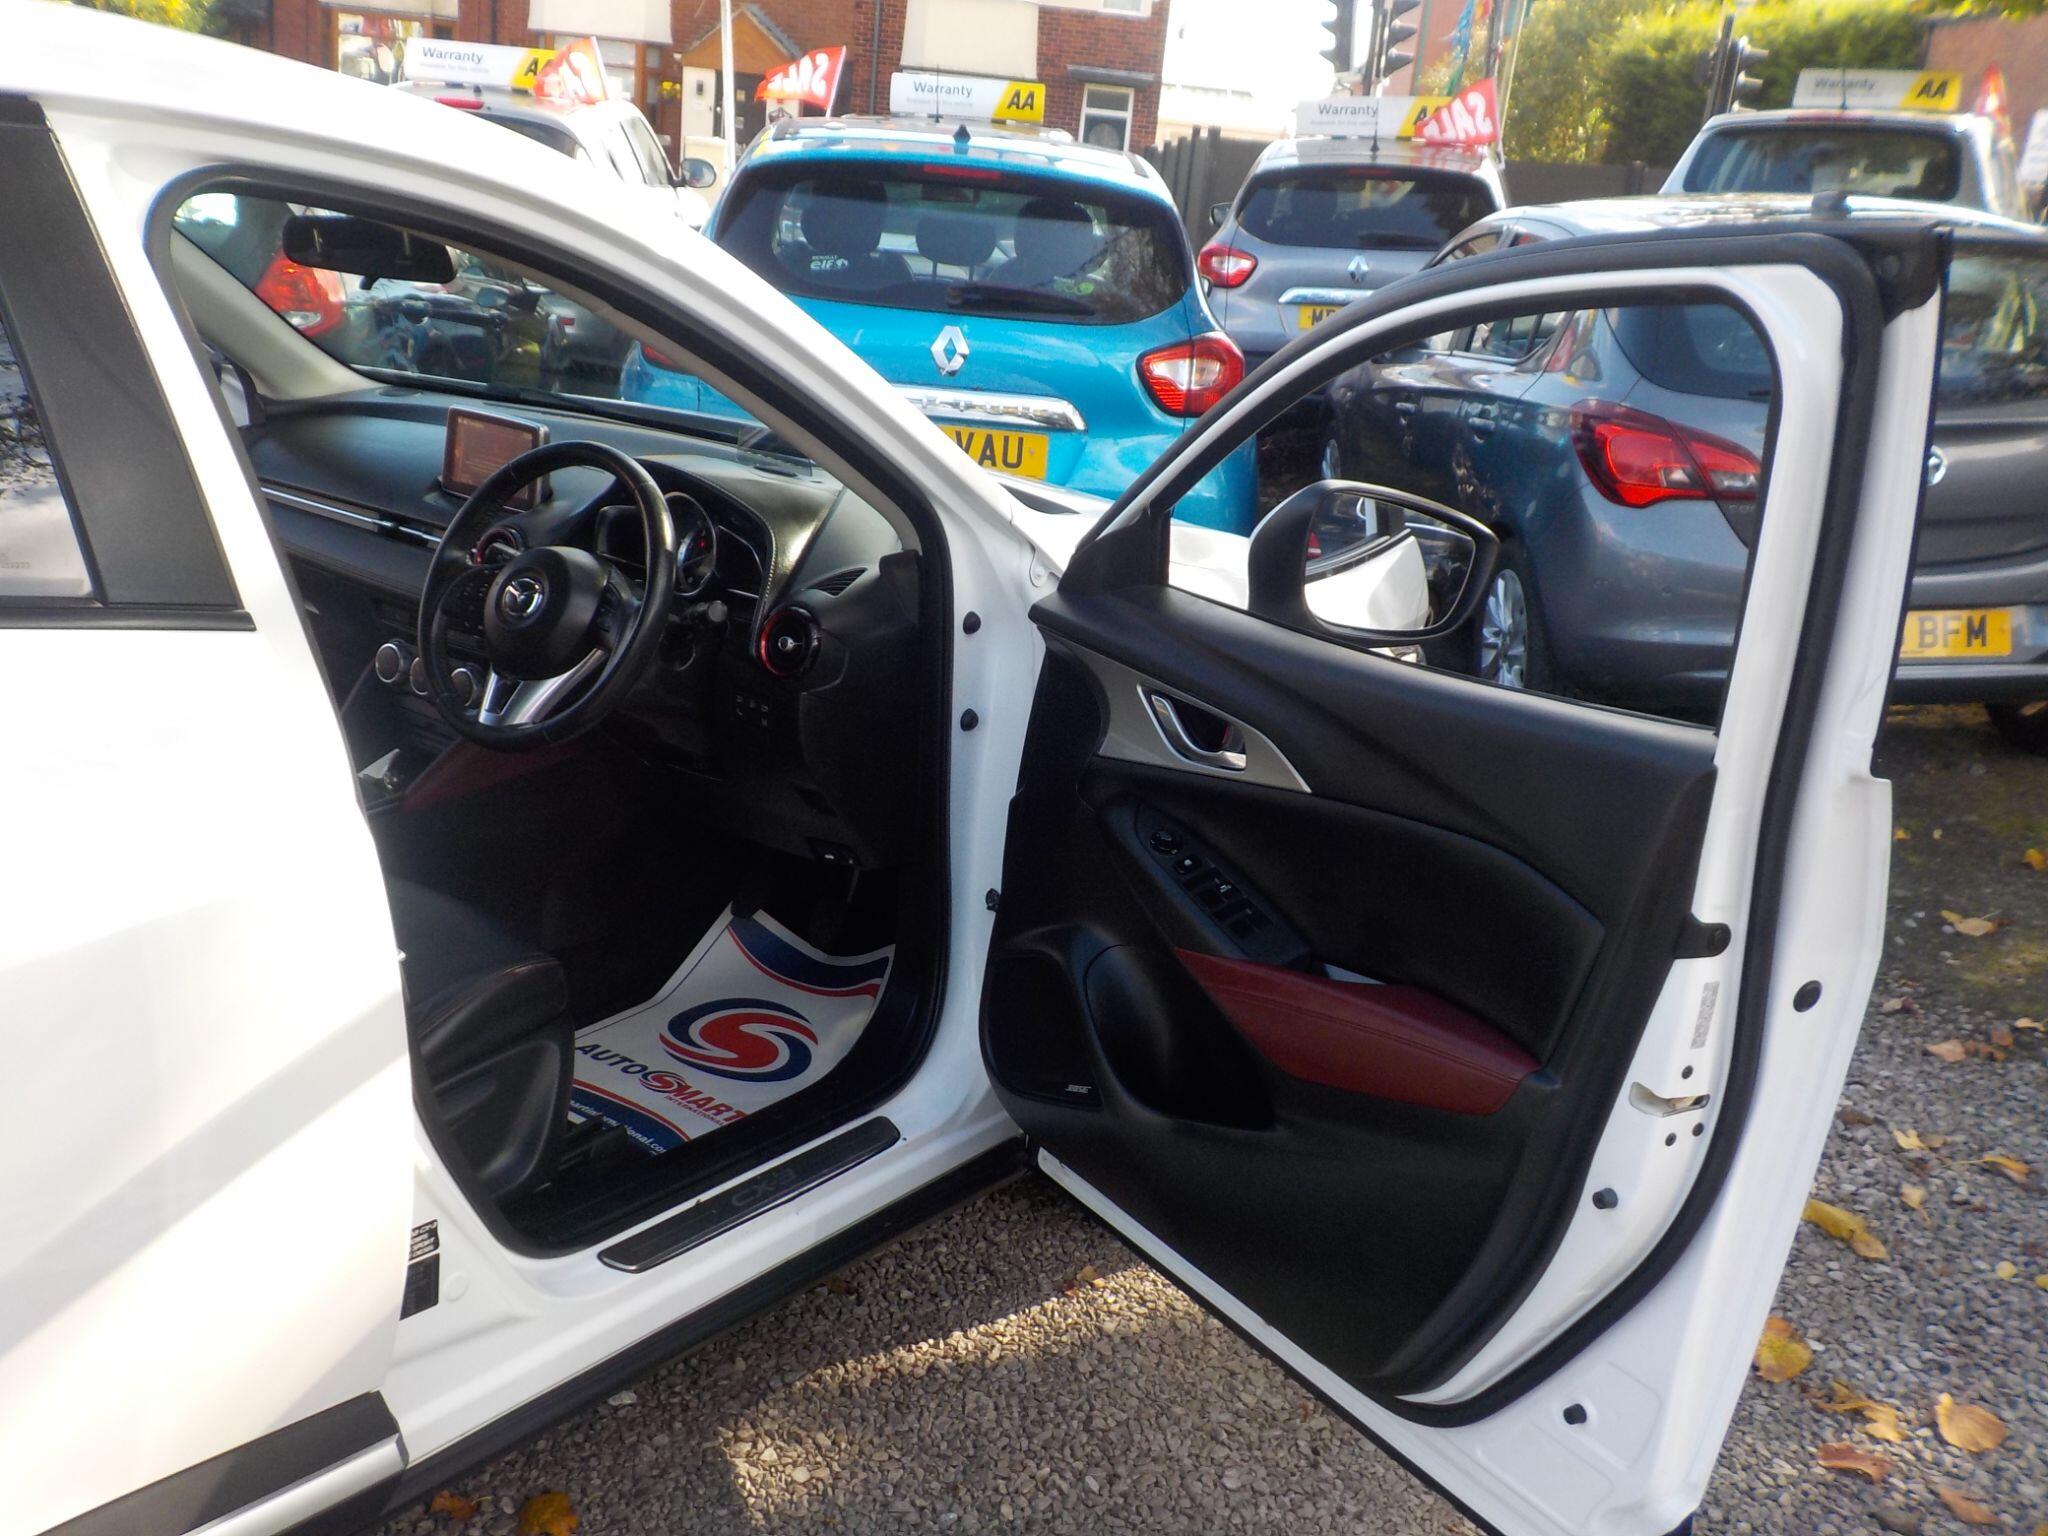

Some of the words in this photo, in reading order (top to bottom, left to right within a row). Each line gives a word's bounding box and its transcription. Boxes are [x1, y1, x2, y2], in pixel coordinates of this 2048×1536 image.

[422, 46, 484, 64] Warranty
[913, 80, 973, 98] Warranty
[1916, 79, 1949, 99] AA
[1007, 88, 1035, 111] AA
[1318, 103, 1378, 118] Warranty
[955, 429, 1025, 469] VAU
[1918, 614, 1987, 649] BFM
